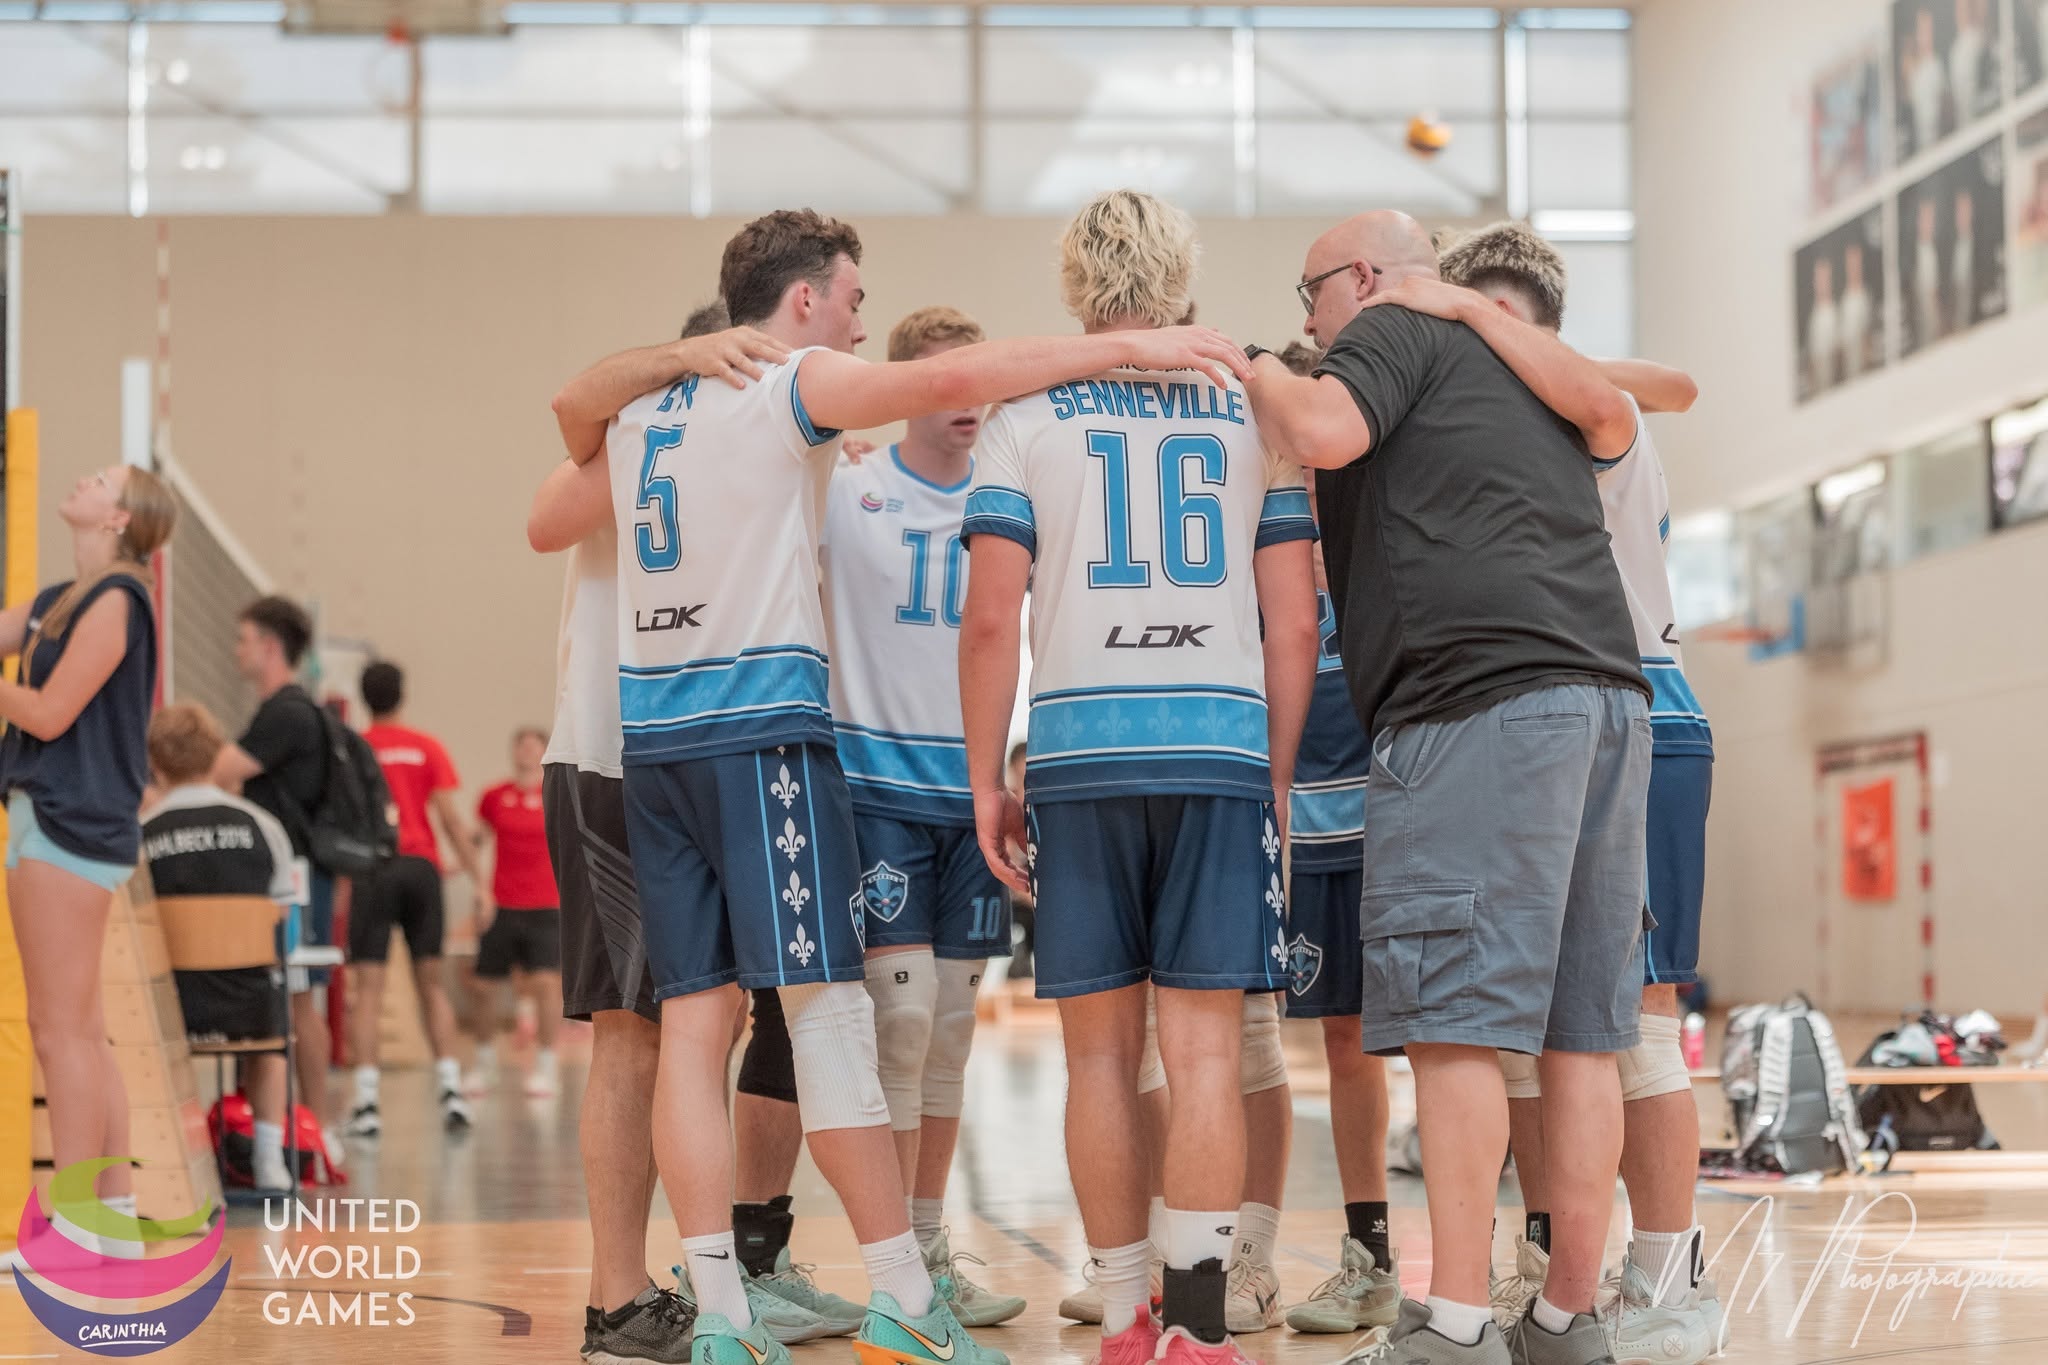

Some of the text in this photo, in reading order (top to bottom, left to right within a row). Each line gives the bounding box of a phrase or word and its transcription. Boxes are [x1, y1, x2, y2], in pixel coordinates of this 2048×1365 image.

[1047, 379, 1245, 426] SENNEVILLE
[634, 422, 687, 574] 5
[1085, 429, 1228, 589] 16
[895, 528, 969, 629] 10
[635, 603, 708, 633] LDK
[1104, 624, 1216, 649] LDK
[967, 896, 1001, 941] 10
